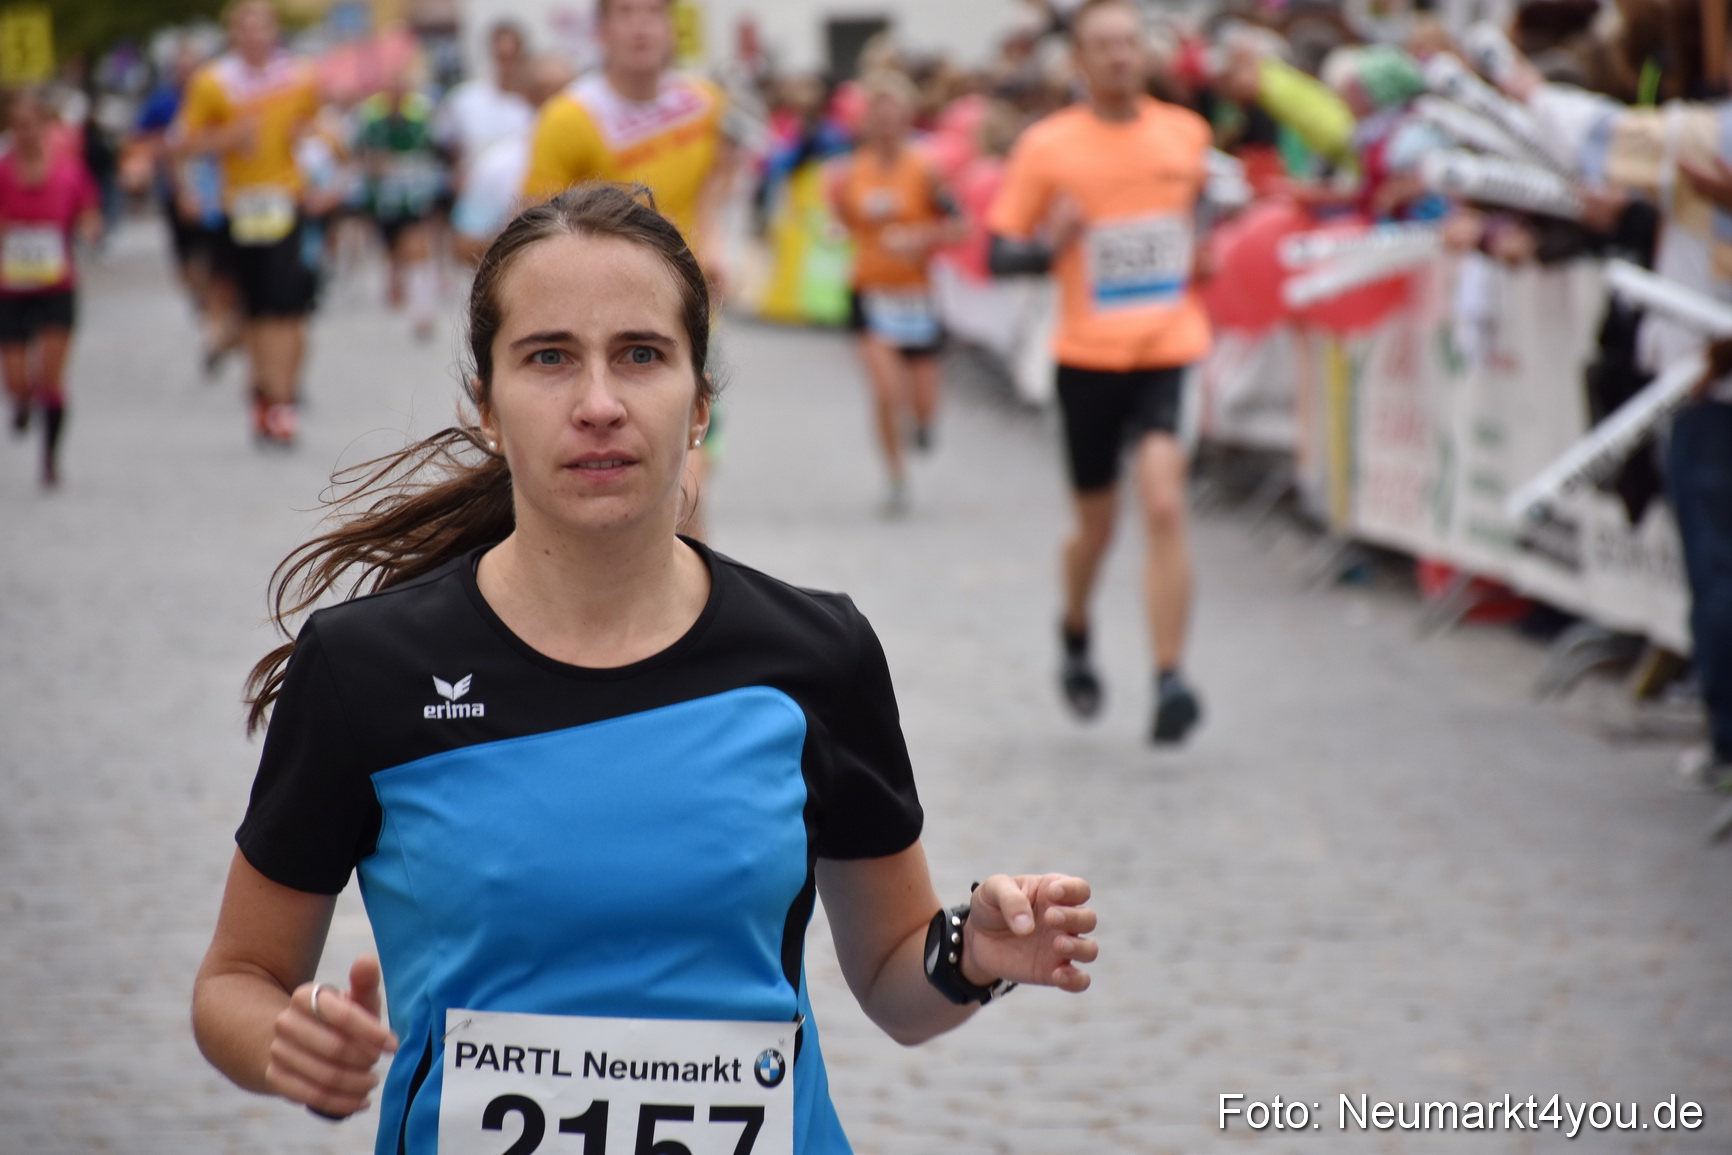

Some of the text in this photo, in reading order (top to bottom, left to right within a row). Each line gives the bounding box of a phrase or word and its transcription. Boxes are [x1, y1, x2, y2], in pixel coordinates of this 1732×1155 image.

[423, 700, 485, 719] erima
[455, 1042, 742, 1083] PARTL Neumarkt
